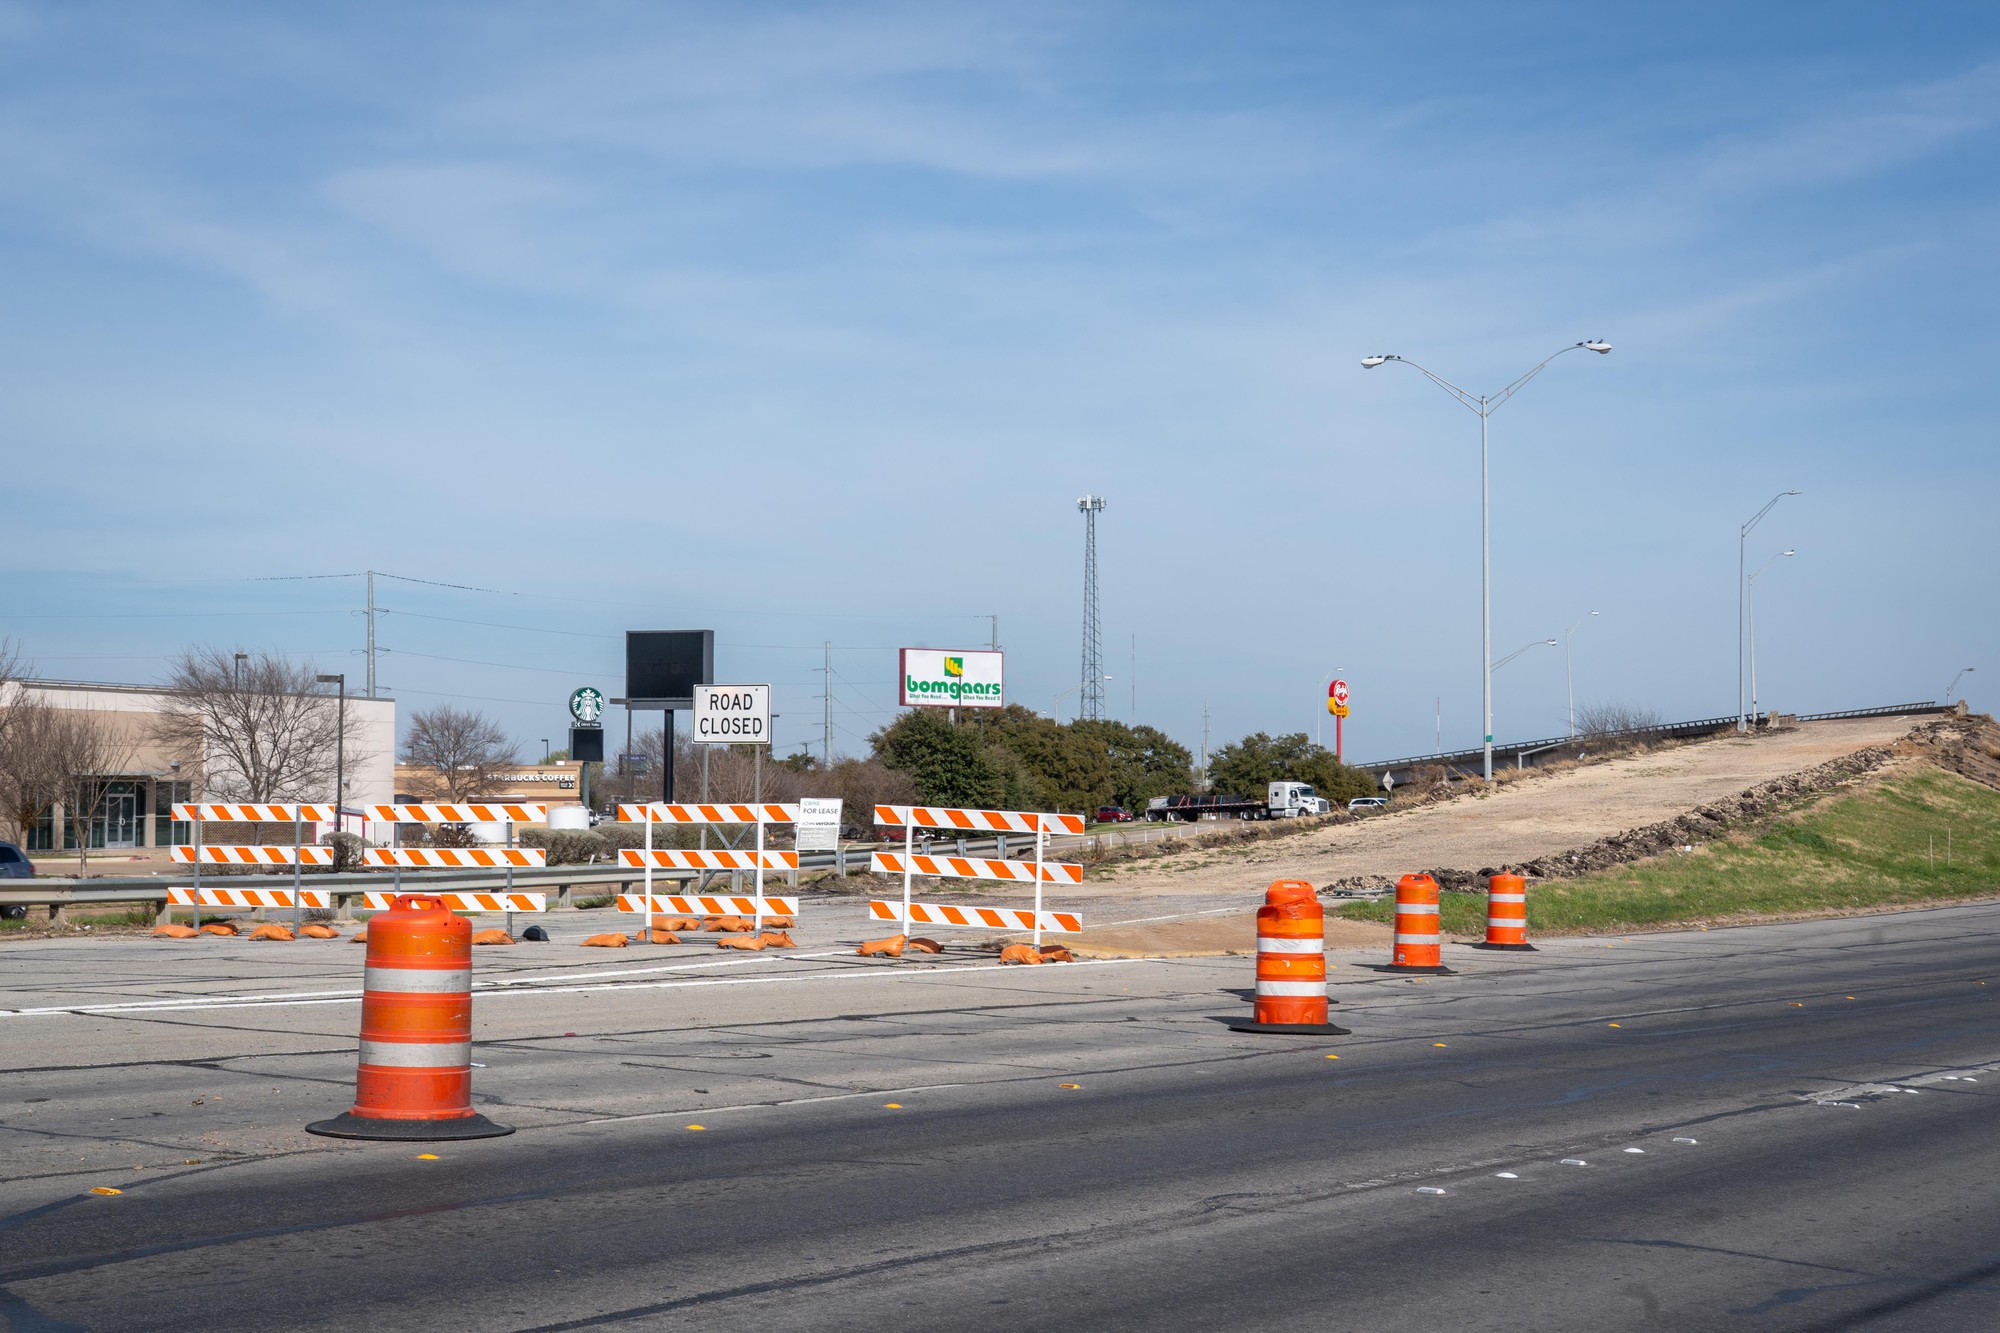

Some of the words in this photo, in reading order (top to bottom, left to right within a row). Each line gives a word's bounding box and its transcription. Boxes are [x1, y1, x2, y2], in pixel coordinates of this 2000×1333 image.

[907, 675, 1001, 700] bomgaars
[709, 693, 753, 711] ROAD
[700, 717, 763, 735] CLOSED
